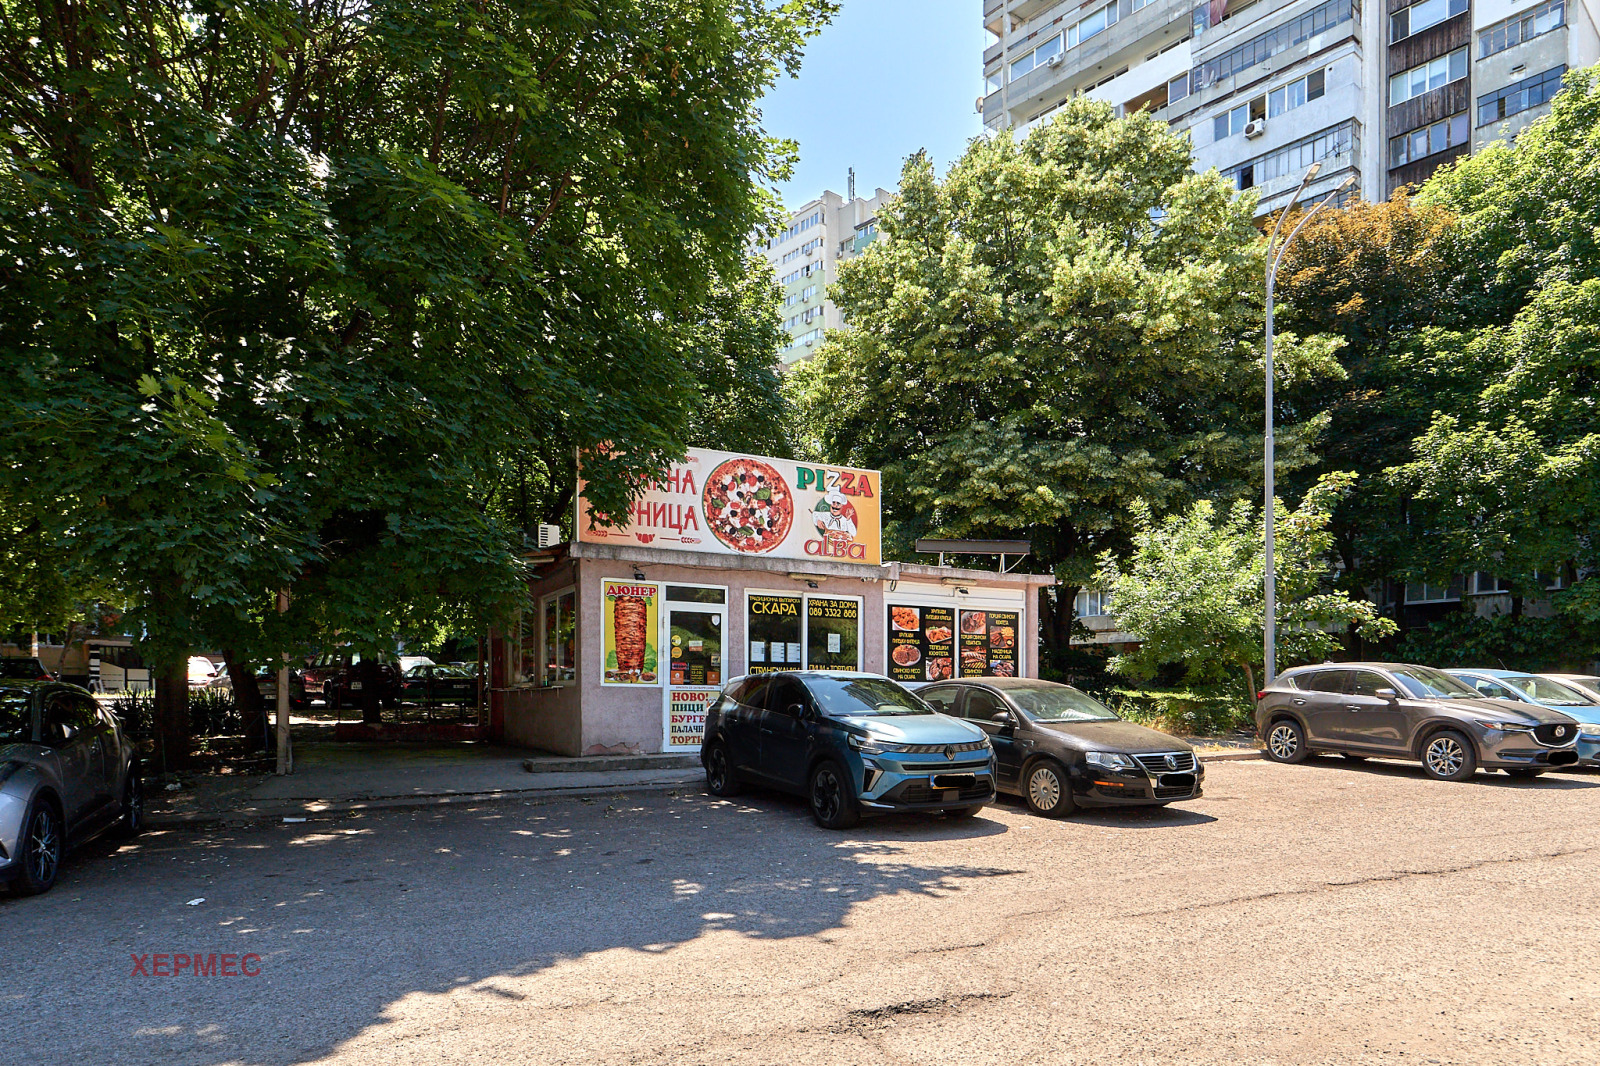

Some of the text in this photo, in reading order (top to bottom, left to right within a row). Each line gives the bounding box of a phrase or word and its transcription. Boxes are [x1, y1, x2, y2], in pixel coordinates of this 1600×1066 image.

[796, 466, 874, 498] PIZZA
[626, 500, 700, 535] НИЦА
[606, 584, 657, 597] ДЮНЕР
[752, 601, 798, 616] СКАРА
[808, 599, 857, 609] ХРАНА ЗА ДОМА
[808, 607, 823, 616] 089
[671, 692, 709, 702] НОВО!
[671, 703, 704, 713] ПИЦИ
